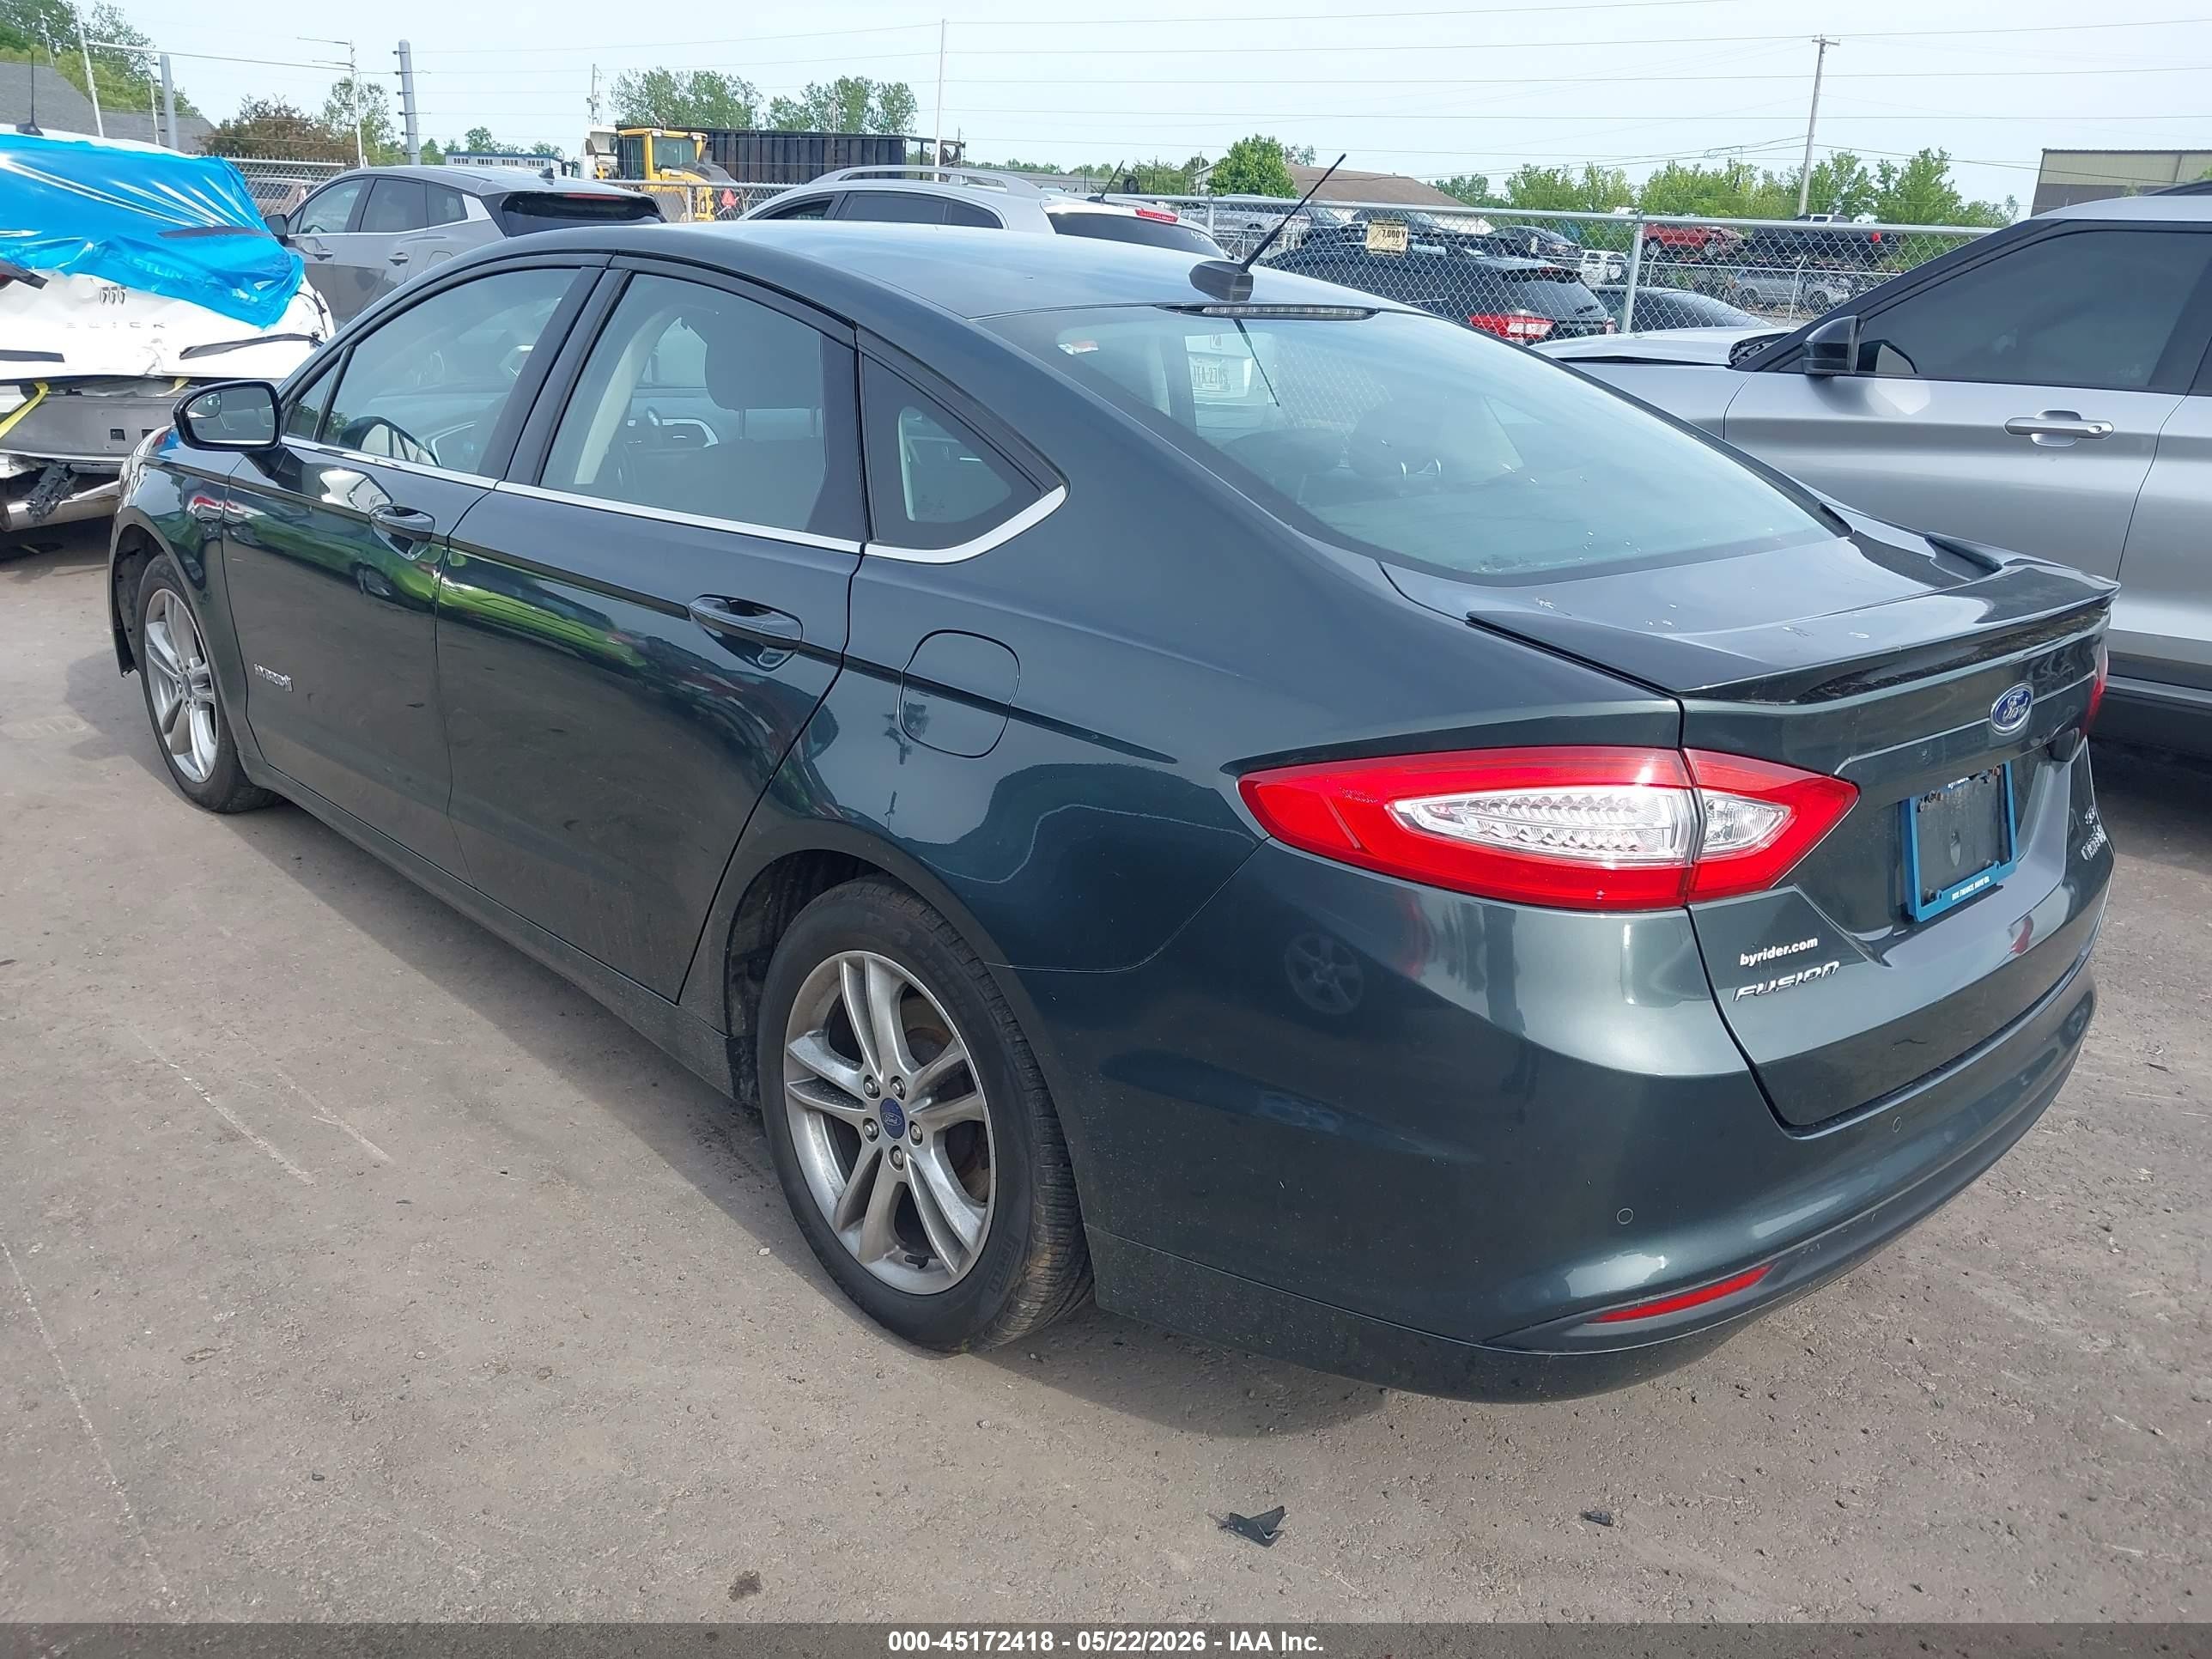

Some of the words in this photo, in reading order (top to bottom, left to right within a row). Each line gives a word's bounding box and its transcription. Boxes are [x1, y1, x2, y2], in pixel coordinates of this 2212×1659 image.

[1382, 229, 1401, 239] 7,000
[1401, 230, 1407, 239] V
[2002, 693, 2029, 721] Ford
[1740, 938, 1819, 967] byrider.com
[1732, 960, 1839, 1001] FUSION
